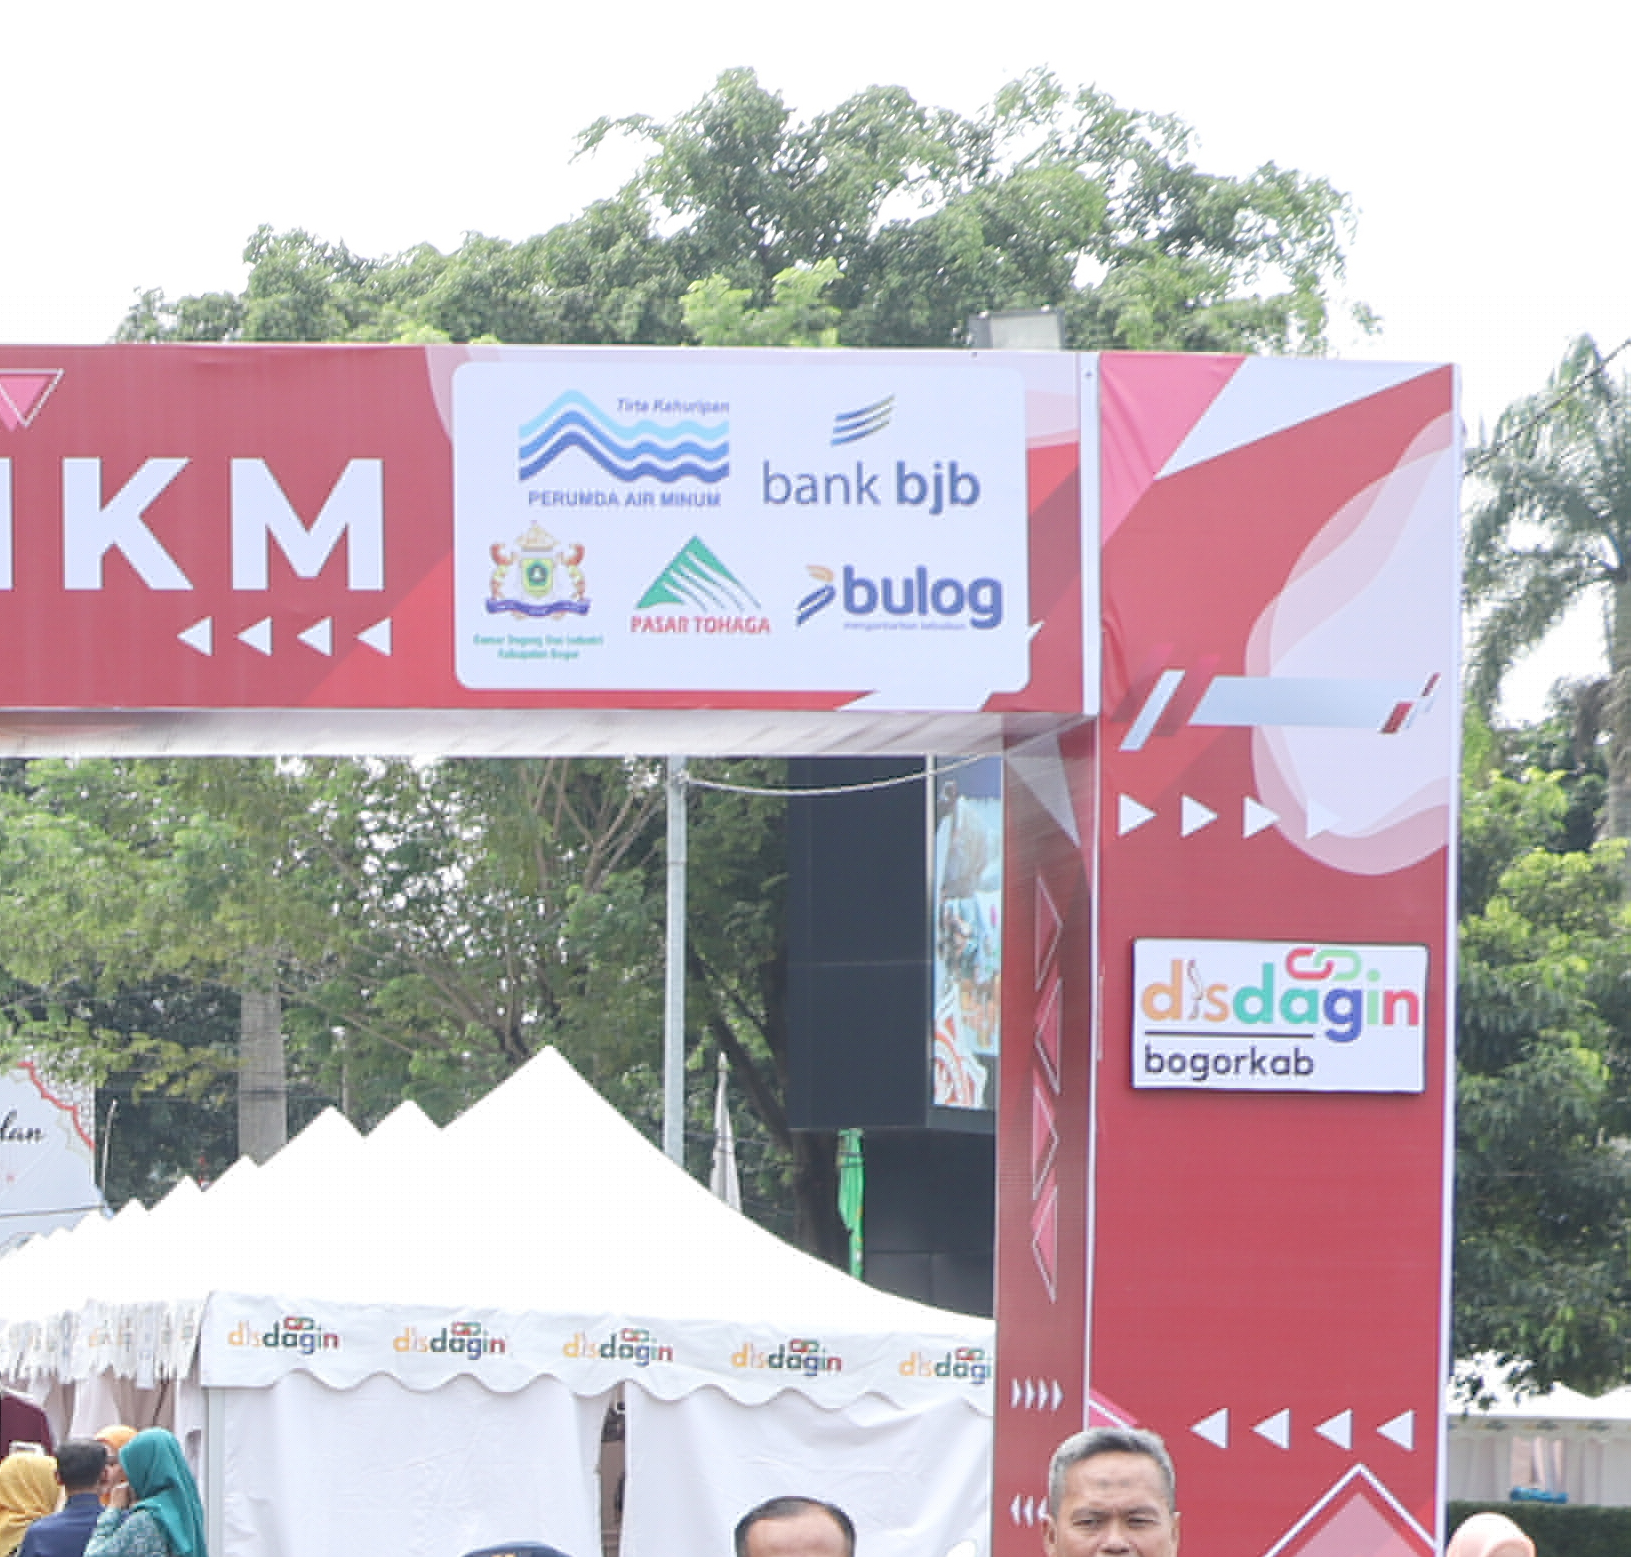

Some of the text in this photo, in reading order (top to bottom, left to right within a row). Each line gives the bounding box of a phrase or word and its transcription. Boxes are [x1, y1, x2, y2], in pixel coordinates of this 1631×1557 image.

[528, 489, 722, 508] PERUMDA AIR MINUM
[763, 459, 980, 515] bank bjb
[843, 564, 1002, 630] bulog
[630, 615, 771, 634] PASAR TOHAGA
[1144, 1044, 1314, 1081] bogorkab
[899, 1351, 994, 1384] disdagi
